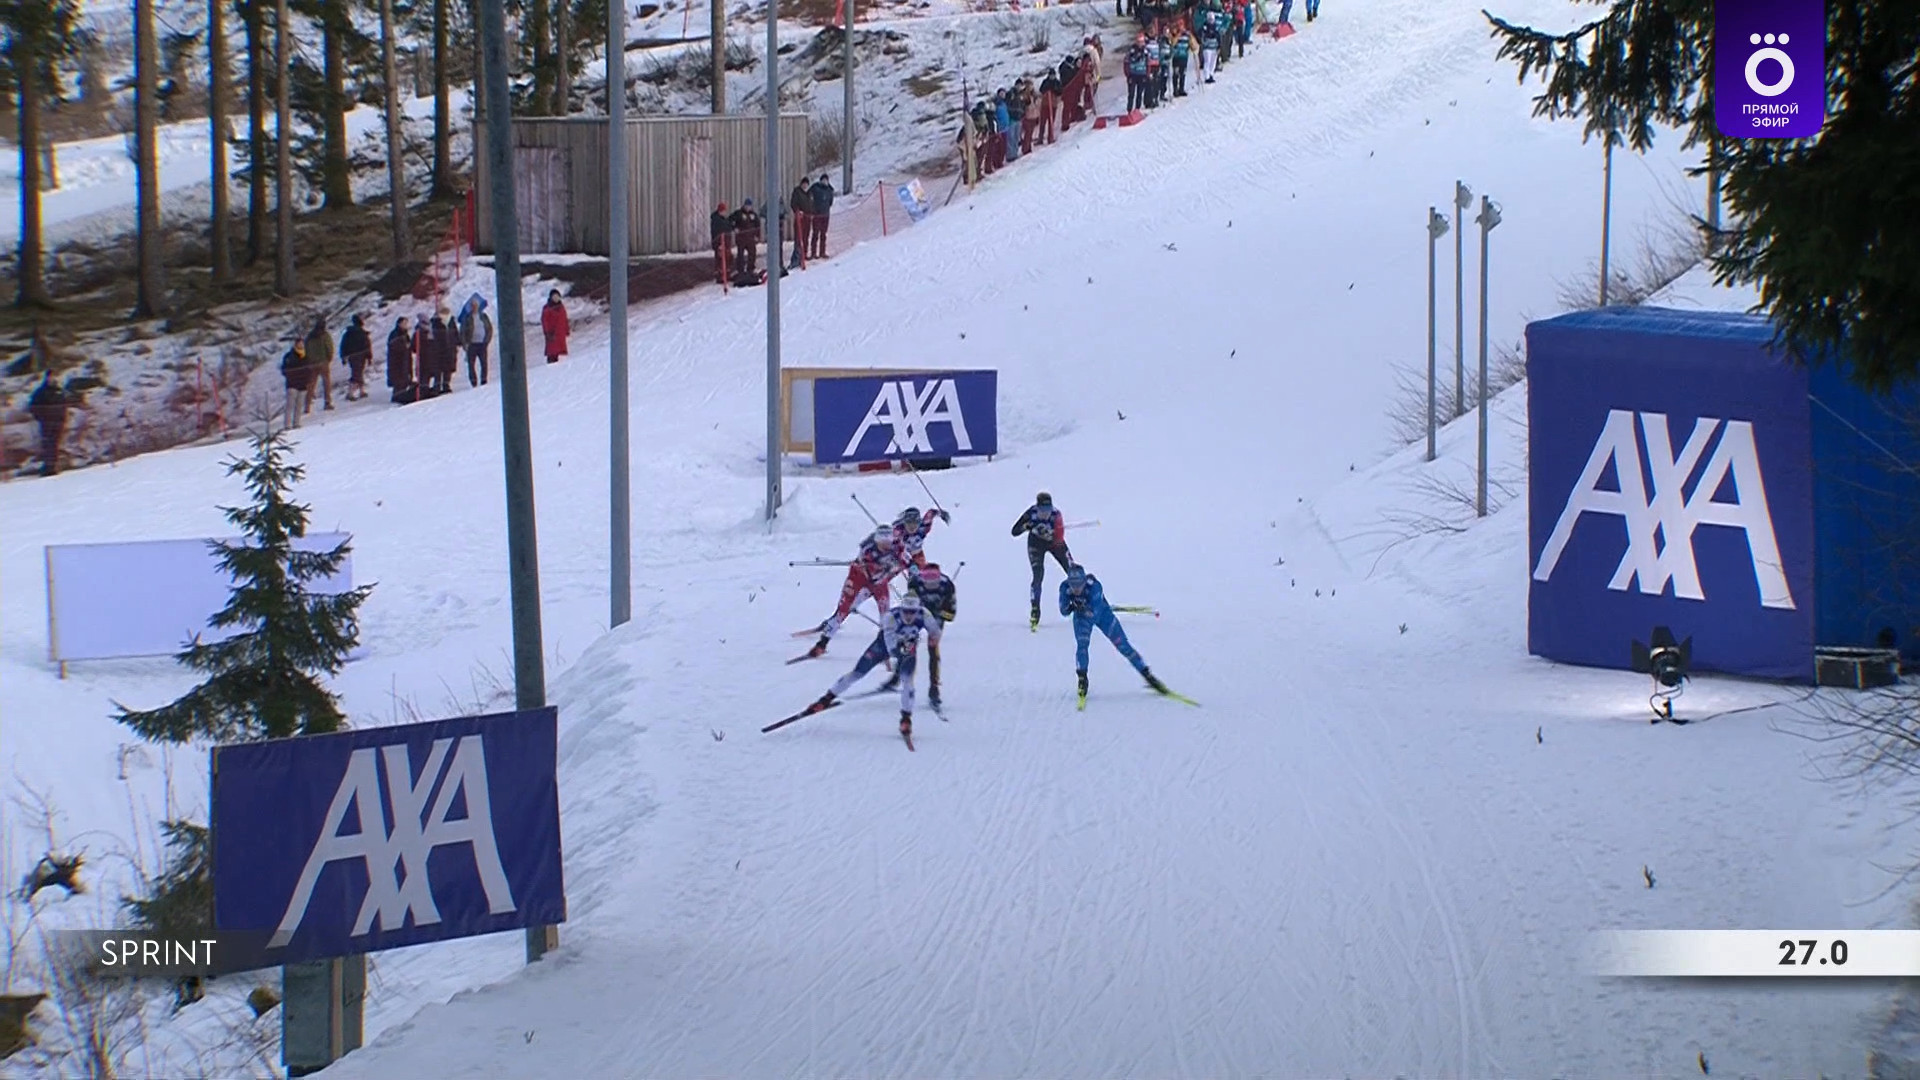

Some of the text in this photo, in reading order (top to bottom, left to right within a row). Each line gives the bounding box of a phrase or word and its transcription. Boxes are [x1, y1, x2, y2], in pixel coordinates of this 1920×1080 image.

[842, 379, 973, 457] AXA
[1533, 409, 1797, 610] AXA
[265, 734, 518, 950] AXA
